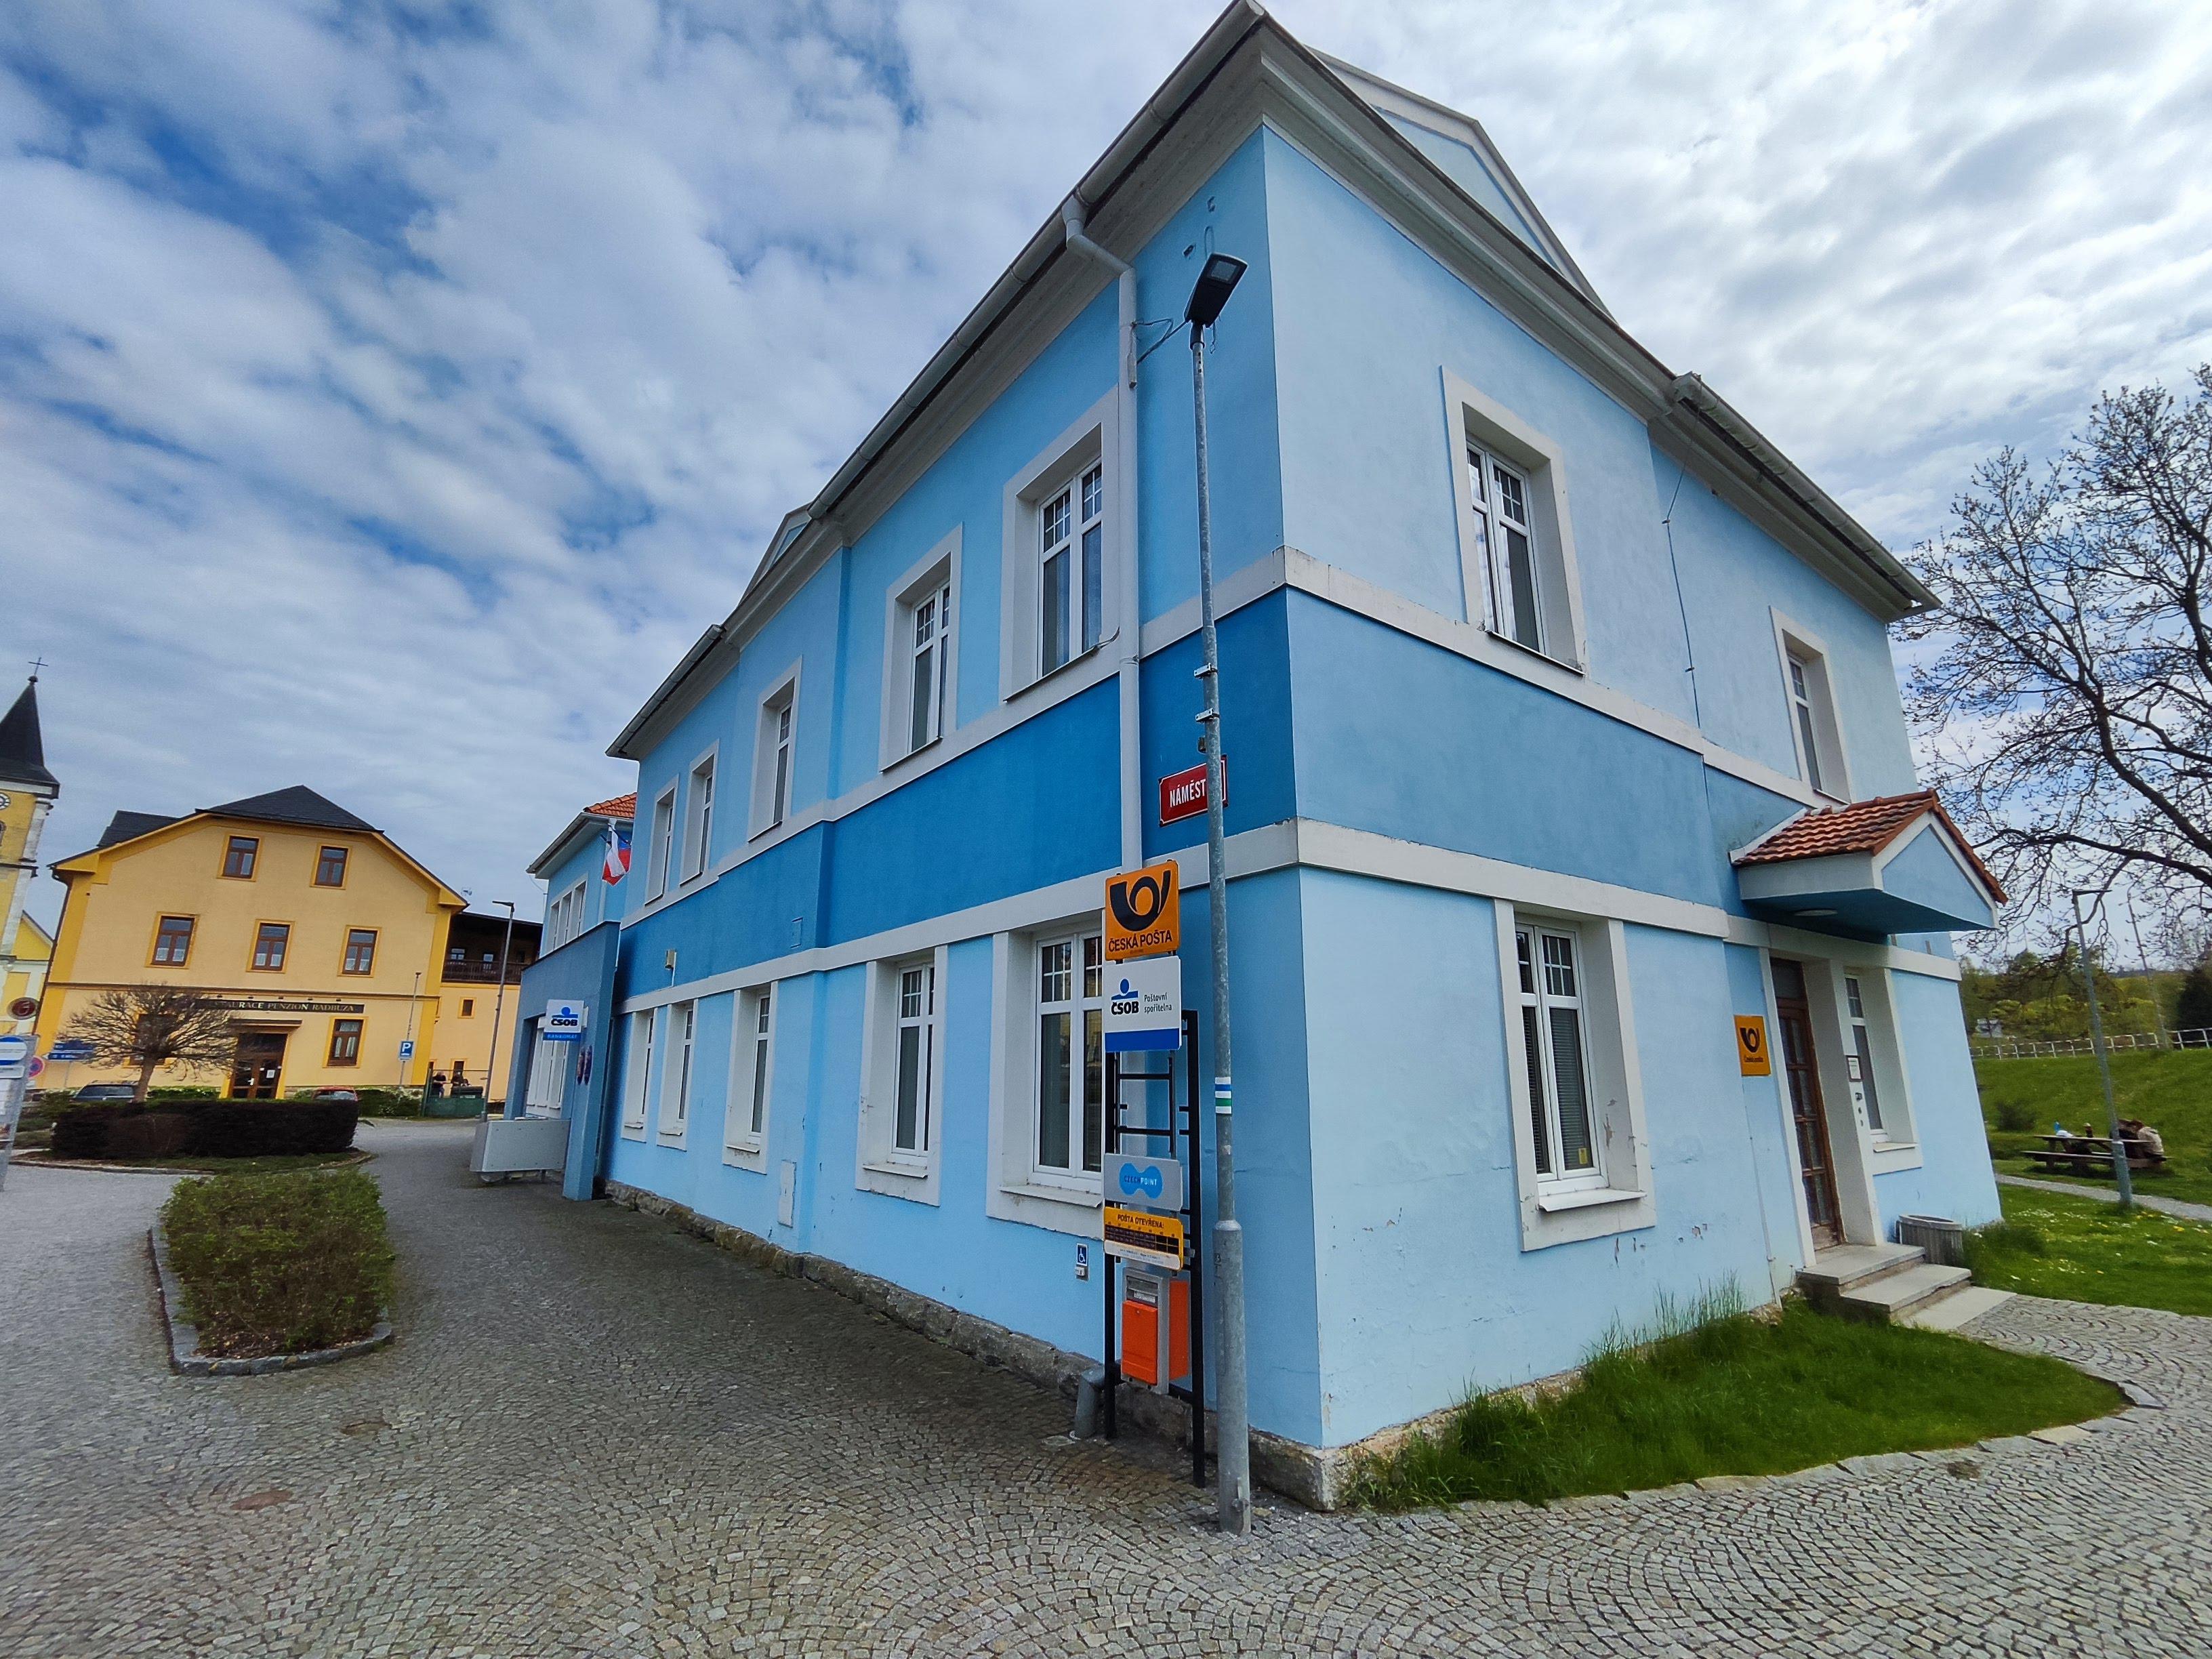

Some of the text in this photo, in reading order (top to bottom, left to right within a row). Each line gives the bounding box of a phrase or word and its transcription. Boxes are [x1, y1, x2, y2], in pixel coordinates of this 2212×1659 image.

[1109, 929, 1172, 951] ČESKÁ POŠTA
[1144, 992, 1167, 1002] Poštovní
[1111, 1002, 1139, 1015] ČSOB
[1144, 1004, 1172, 1014] spořitelna
[402, 1043, 411, 1052] P
